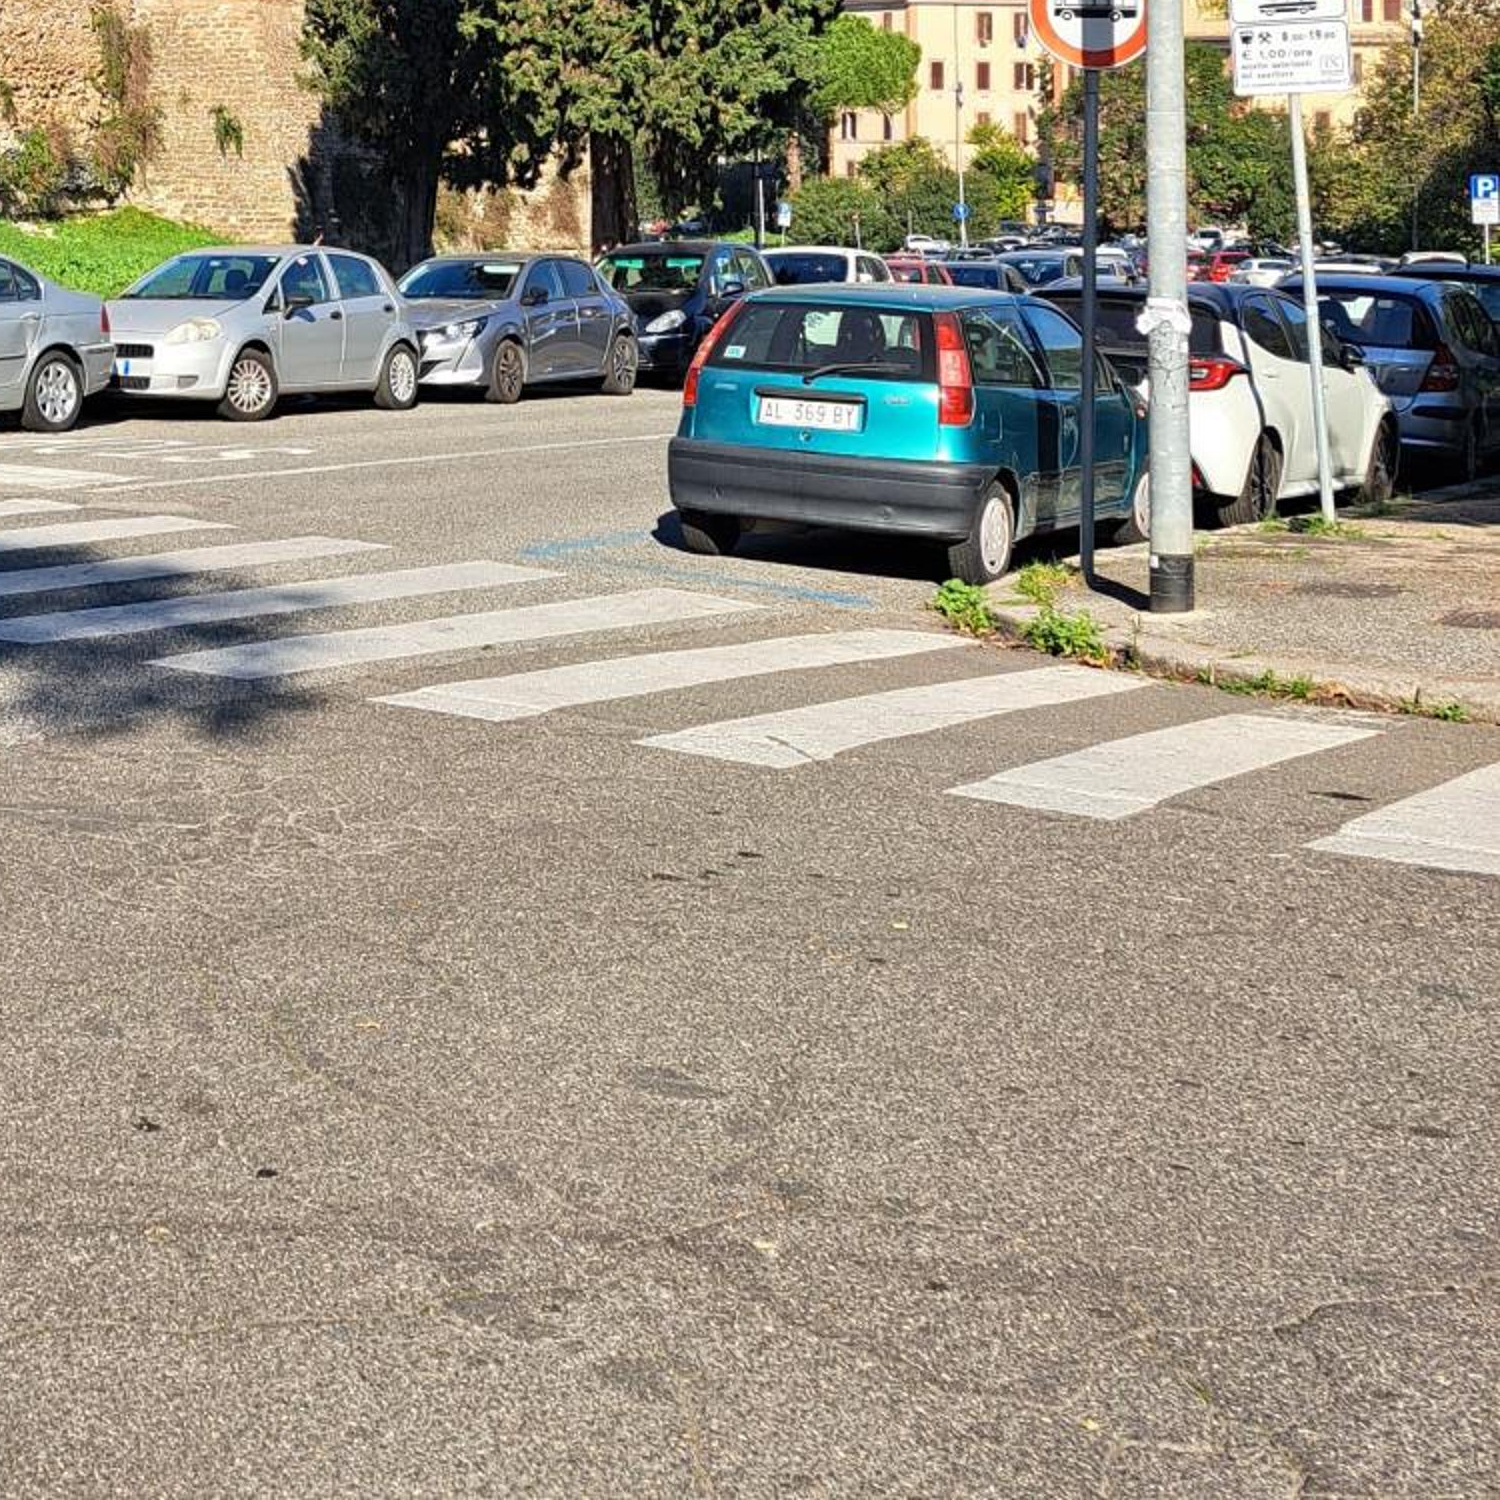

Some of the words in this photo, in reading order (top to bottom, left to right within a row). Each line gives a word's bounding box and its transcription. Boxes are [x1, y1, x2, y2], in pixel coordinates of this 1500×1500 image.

[1477, 175, 1495, 197] P
[765, 402, 783, 419] AL
[794, 403, 826, 422] 369
[833, 405, 855, 426] BY
